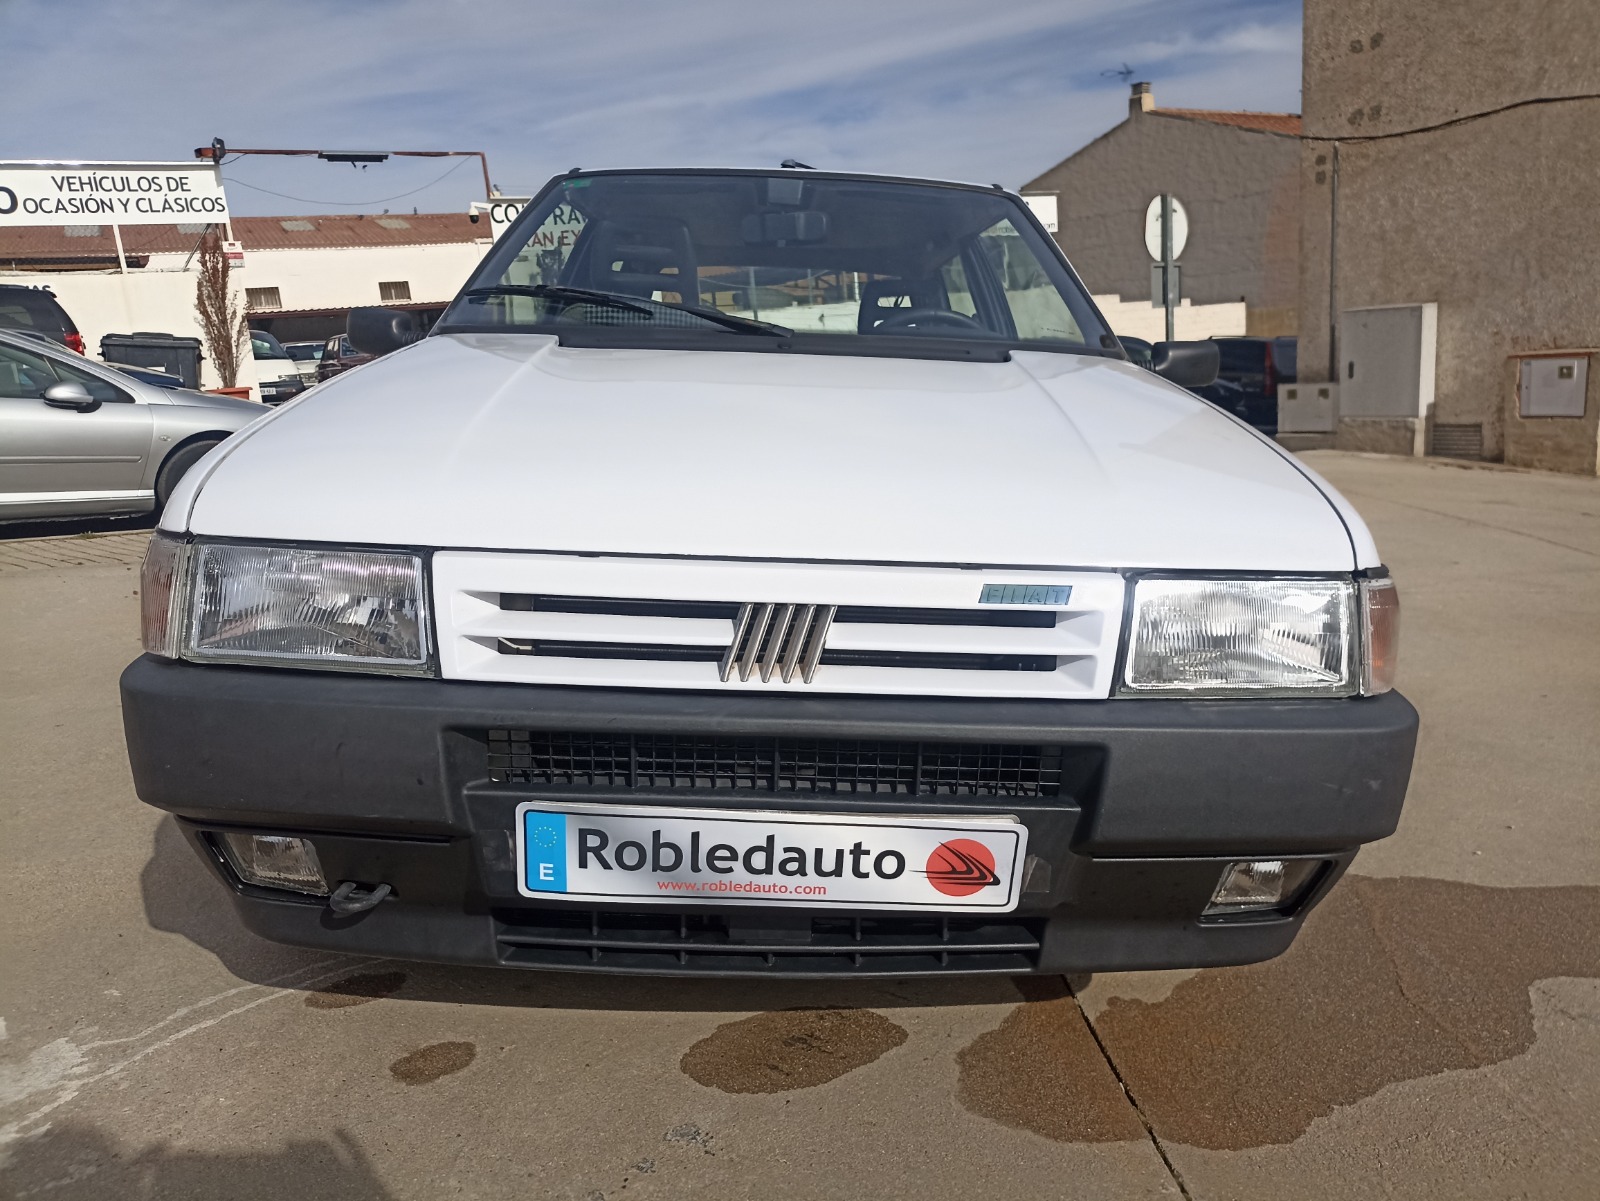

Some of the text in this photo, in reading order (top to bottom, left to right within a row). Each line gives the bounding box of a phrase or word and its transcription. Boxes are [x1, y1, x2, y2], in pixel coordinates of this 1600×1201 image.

[51, 172, 192, 192] VEHÍCULOS DE
[23, 194, 226, 214] OCASIÓN Y CLÁSICOS
[985, 587, 1065, 604] FIAT
[578, 828, 907, 880] Robledauto
[538, 863, 555, 880] E
[657, 879, 827, 895] www.robledauto.com
